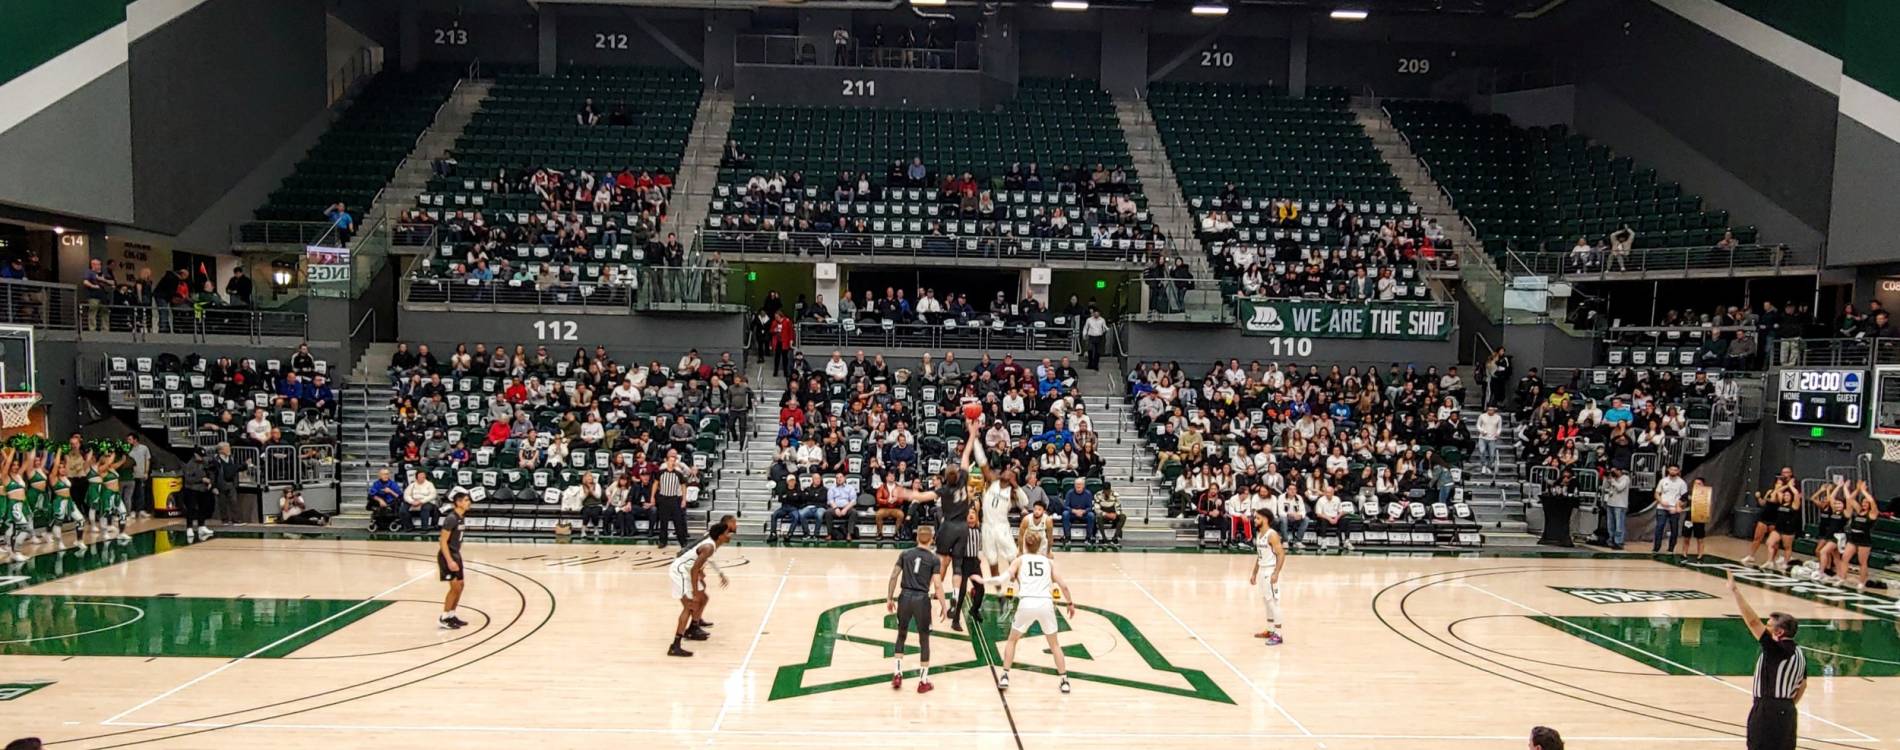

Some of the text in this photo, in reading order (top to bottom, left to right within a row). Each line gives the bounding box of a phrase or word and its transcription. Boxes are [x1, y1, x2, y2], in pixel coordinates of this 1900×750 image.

[434, 29, 468, 45] 213
[595, 33, 628, 49] 212
[1201, 52, 1233, 67] 210
[1398, 59, 1430, 74] 209
[842, 79, 875, 96] 211
[62, 235, 84, 247] C14
[1292, 307, 1445, 336] WE ARE THE SHIP
[533, 320, 578, 340] 112
[1268, 336, 1313, 357] 110
[1800, 372, 1840, 391] 20:00
[1783, 392, 1858, 403] HOME GUEST
[1791, 401, 1802, 420] 0
[1846, 404, 1858, 423] 0
[913, 557, 922, 574] 1
[1028, 561, 1044, 577] 15
